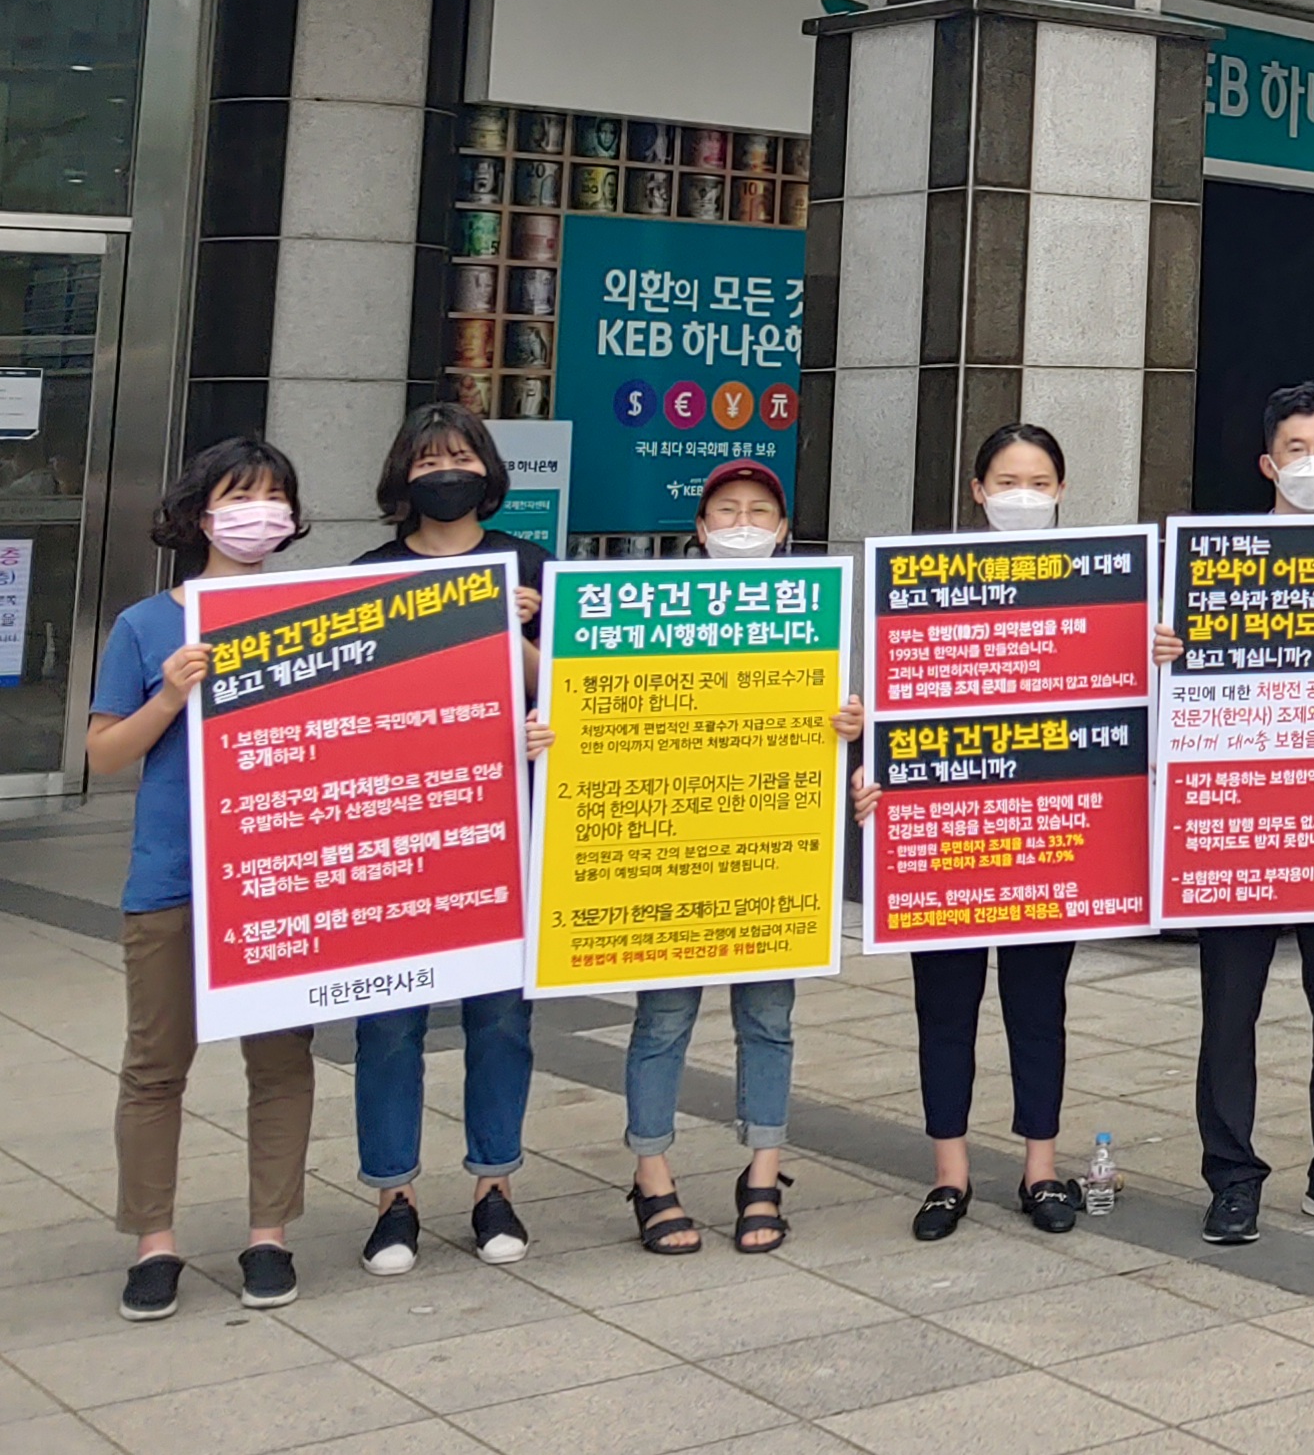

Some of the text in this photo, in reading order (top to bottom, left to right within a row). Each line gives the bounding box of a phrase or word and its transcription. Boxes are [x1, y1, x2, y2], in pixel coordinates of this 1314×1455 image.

[603, 268, 700, 315] 외환의
[709, 275, 772, 318] 모든
[598, 318, 673, 357] KEB
[635, 441, 776, 458] 국내 최다 외국화폐 종류 보유
[1191, 535, 1271, 557] 내가 먹는
[1094, 553, 1132, 575] 대해
[1190, 557, 1266, 586] 한약이
[889, 585, 1017, 609] 알고 계십니까?
[1187, 591, 1227, 611] 다른
[1230, 590, 1268, 611] 약과
[212, 569, 500, 674] 첩약 건강보험 시범사업,
[575, 620, 820, 650] 이렇게 시행해야 합니다.
[1187, 613, 1238, 642] 같이
[212, 639, 377, 705] 알고 계십니까?
[1186, 647, 1312, 669] 알고 계십니까?
[583, 668, 825, 694] 행위가 이루어진 곳에 행위료수가를
[1172, 685, 1216, 700] 국민에
[1222, 685, 1251, 700] 대한
[1257, 682, 1302, 699] 처방전
[889, 719, 1128, 759] 첩약 건강보험에 대해
[889, 758, 1017, 785] 알고 계십니까?
[309, 966, 435, 1008] 대한한약사회
